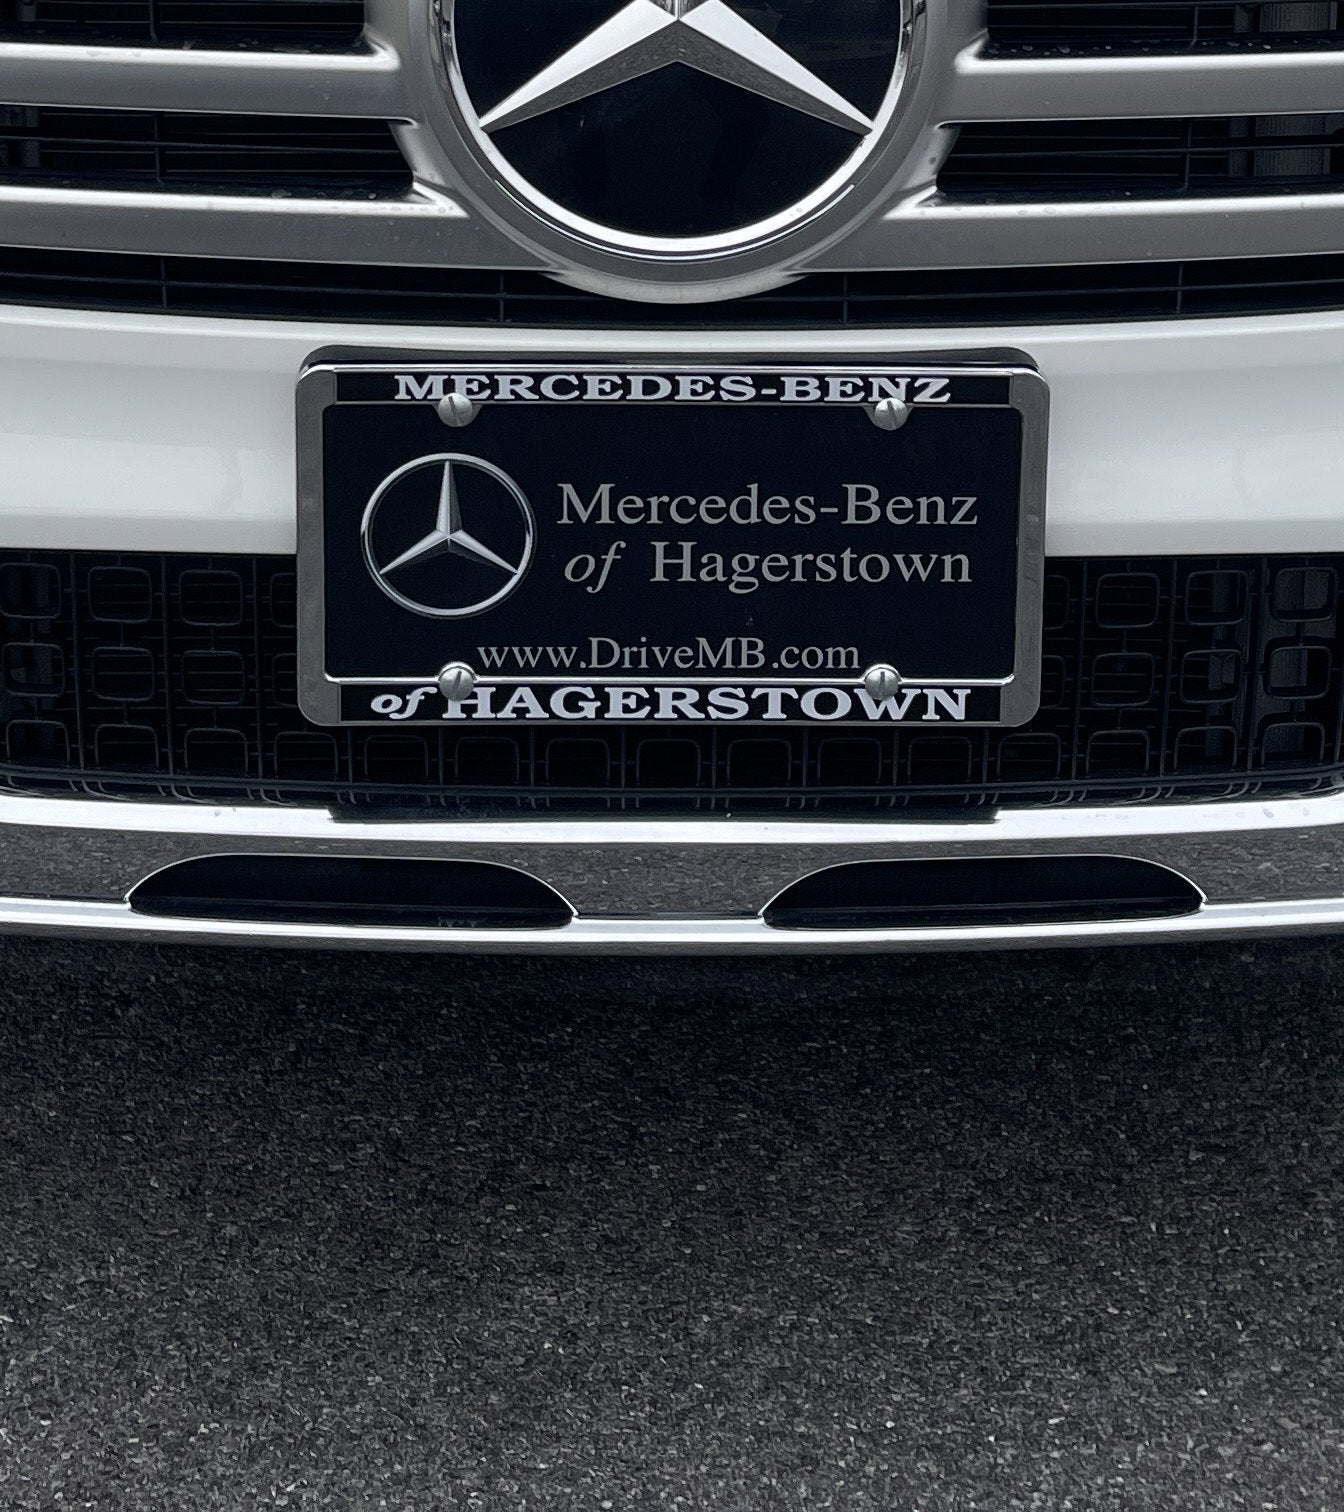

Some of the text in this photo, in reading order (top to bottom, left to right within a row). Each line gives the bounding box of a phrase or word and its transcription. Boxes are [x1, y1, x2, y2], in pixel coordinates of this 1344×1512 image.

[394, 374, 952, 403] MERCEDES-BENZ
[556, 483, 978, 525] Mercedes-Benz
[563, 540, 972, 594] of Hagerstown
[476, 636, 861, 670] www.DriveMB.com
[370, 686, 972, 720] of HAGERSTOWN
